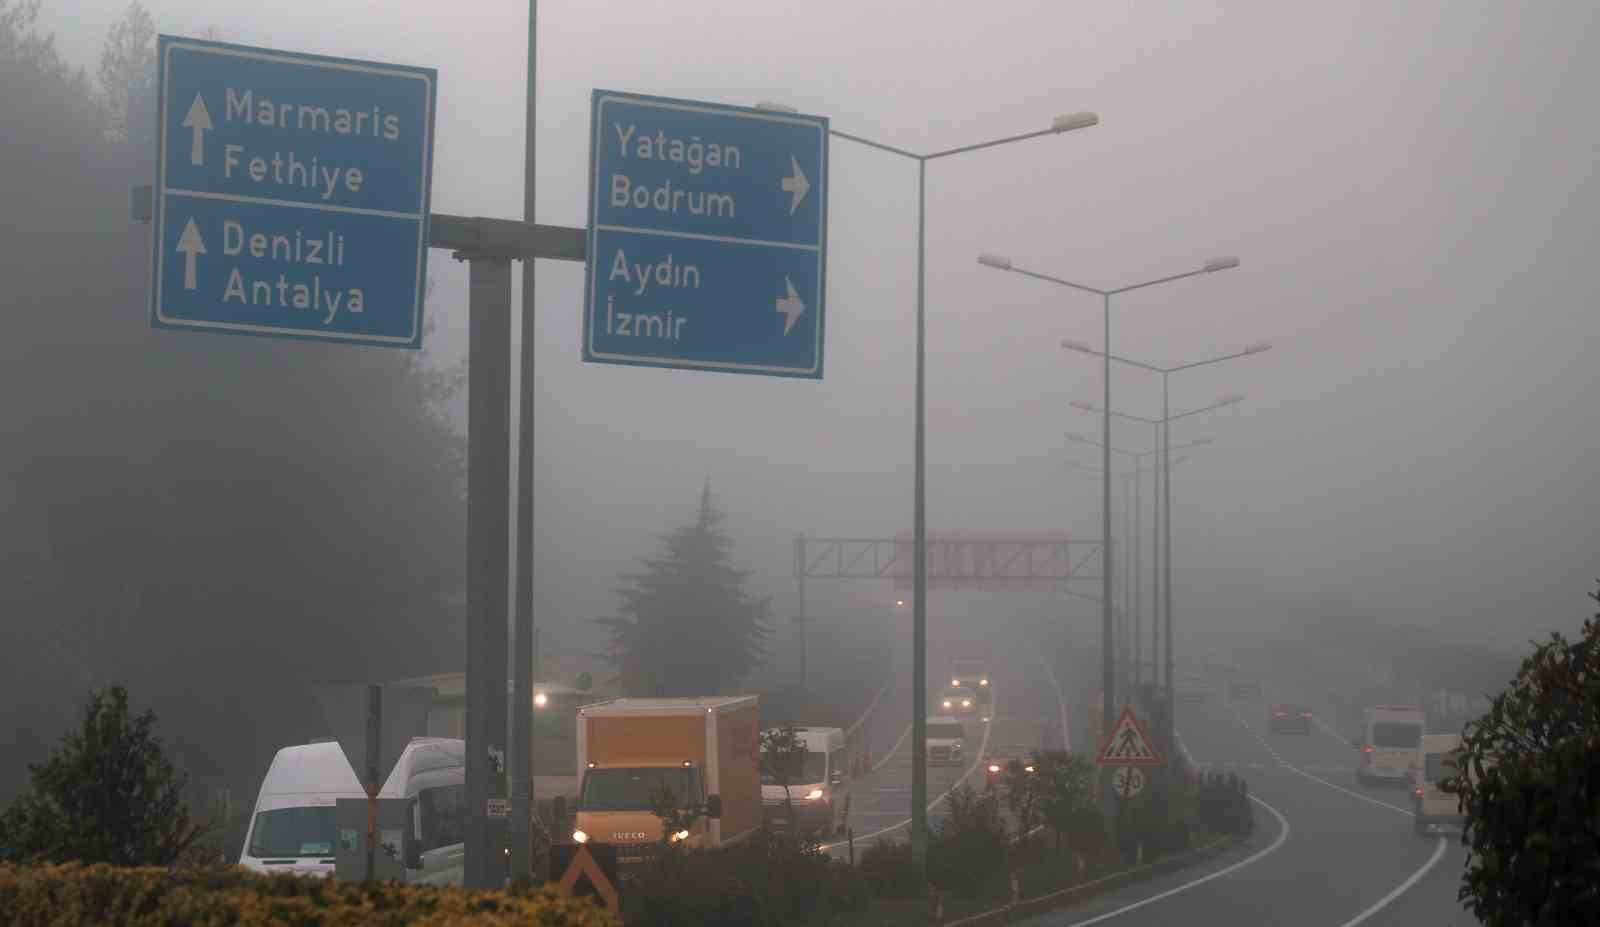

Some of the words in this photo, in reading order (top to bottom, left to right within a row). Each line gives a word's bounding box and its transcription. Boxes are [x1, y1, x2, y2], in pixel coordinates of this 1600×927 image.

[223, 87, 401, 140] Marmaris
[223, 143, 364, 199] Fethiye
[615, 122, 740, 174] Yatağan
[610, 173, 735, 218] Bodrum
[222, 219, 344, 265] Denizli
[222, 268, 364, 325] Antalya
[608, 248, 700, 296] Aydın
[606, 295, 687, 339] İzmir
